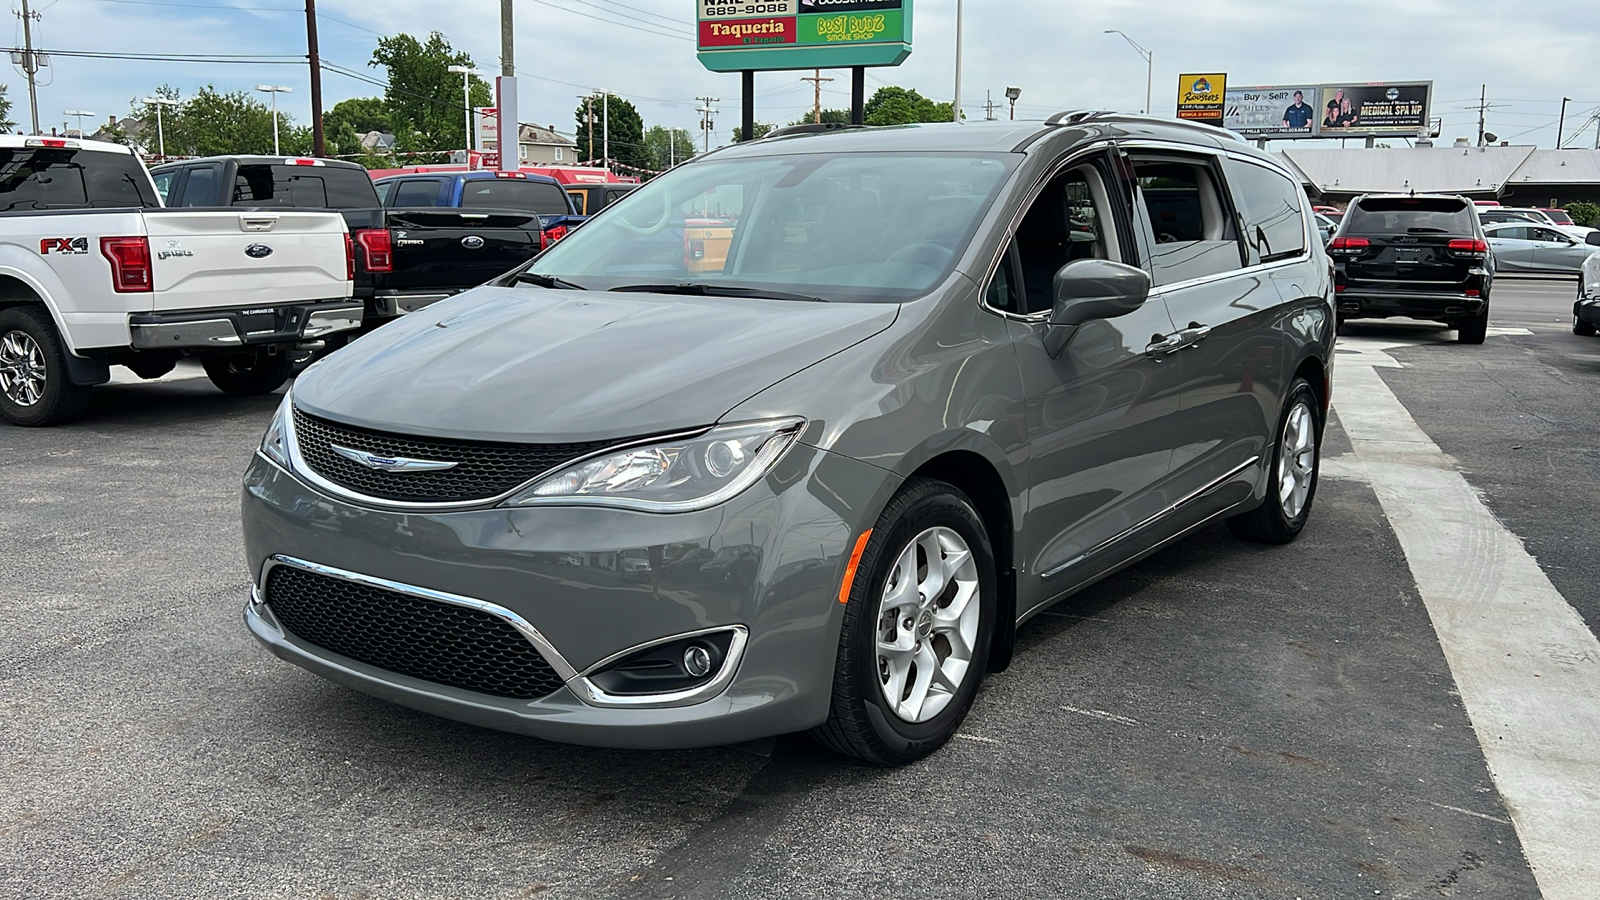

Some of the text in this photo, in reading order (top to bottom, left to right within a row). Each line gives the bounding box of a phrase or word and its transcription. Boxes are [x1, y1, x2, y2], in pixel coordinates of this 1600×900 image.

[705, 3, 788, 16] 689-9088
[826, 32, 875, 42] SMOKE SHOP
[1183, 91, 1219, 103] Roosters
[1244, 93, 1261, 102] Buy
[1268, 92, 1289, 100] Sell?
[1360, 104, 1423, 116] MEDICAL SPA NP
[40, 237, 89, 255] FX4
[1399, 236, 1419, 244] Jeep
